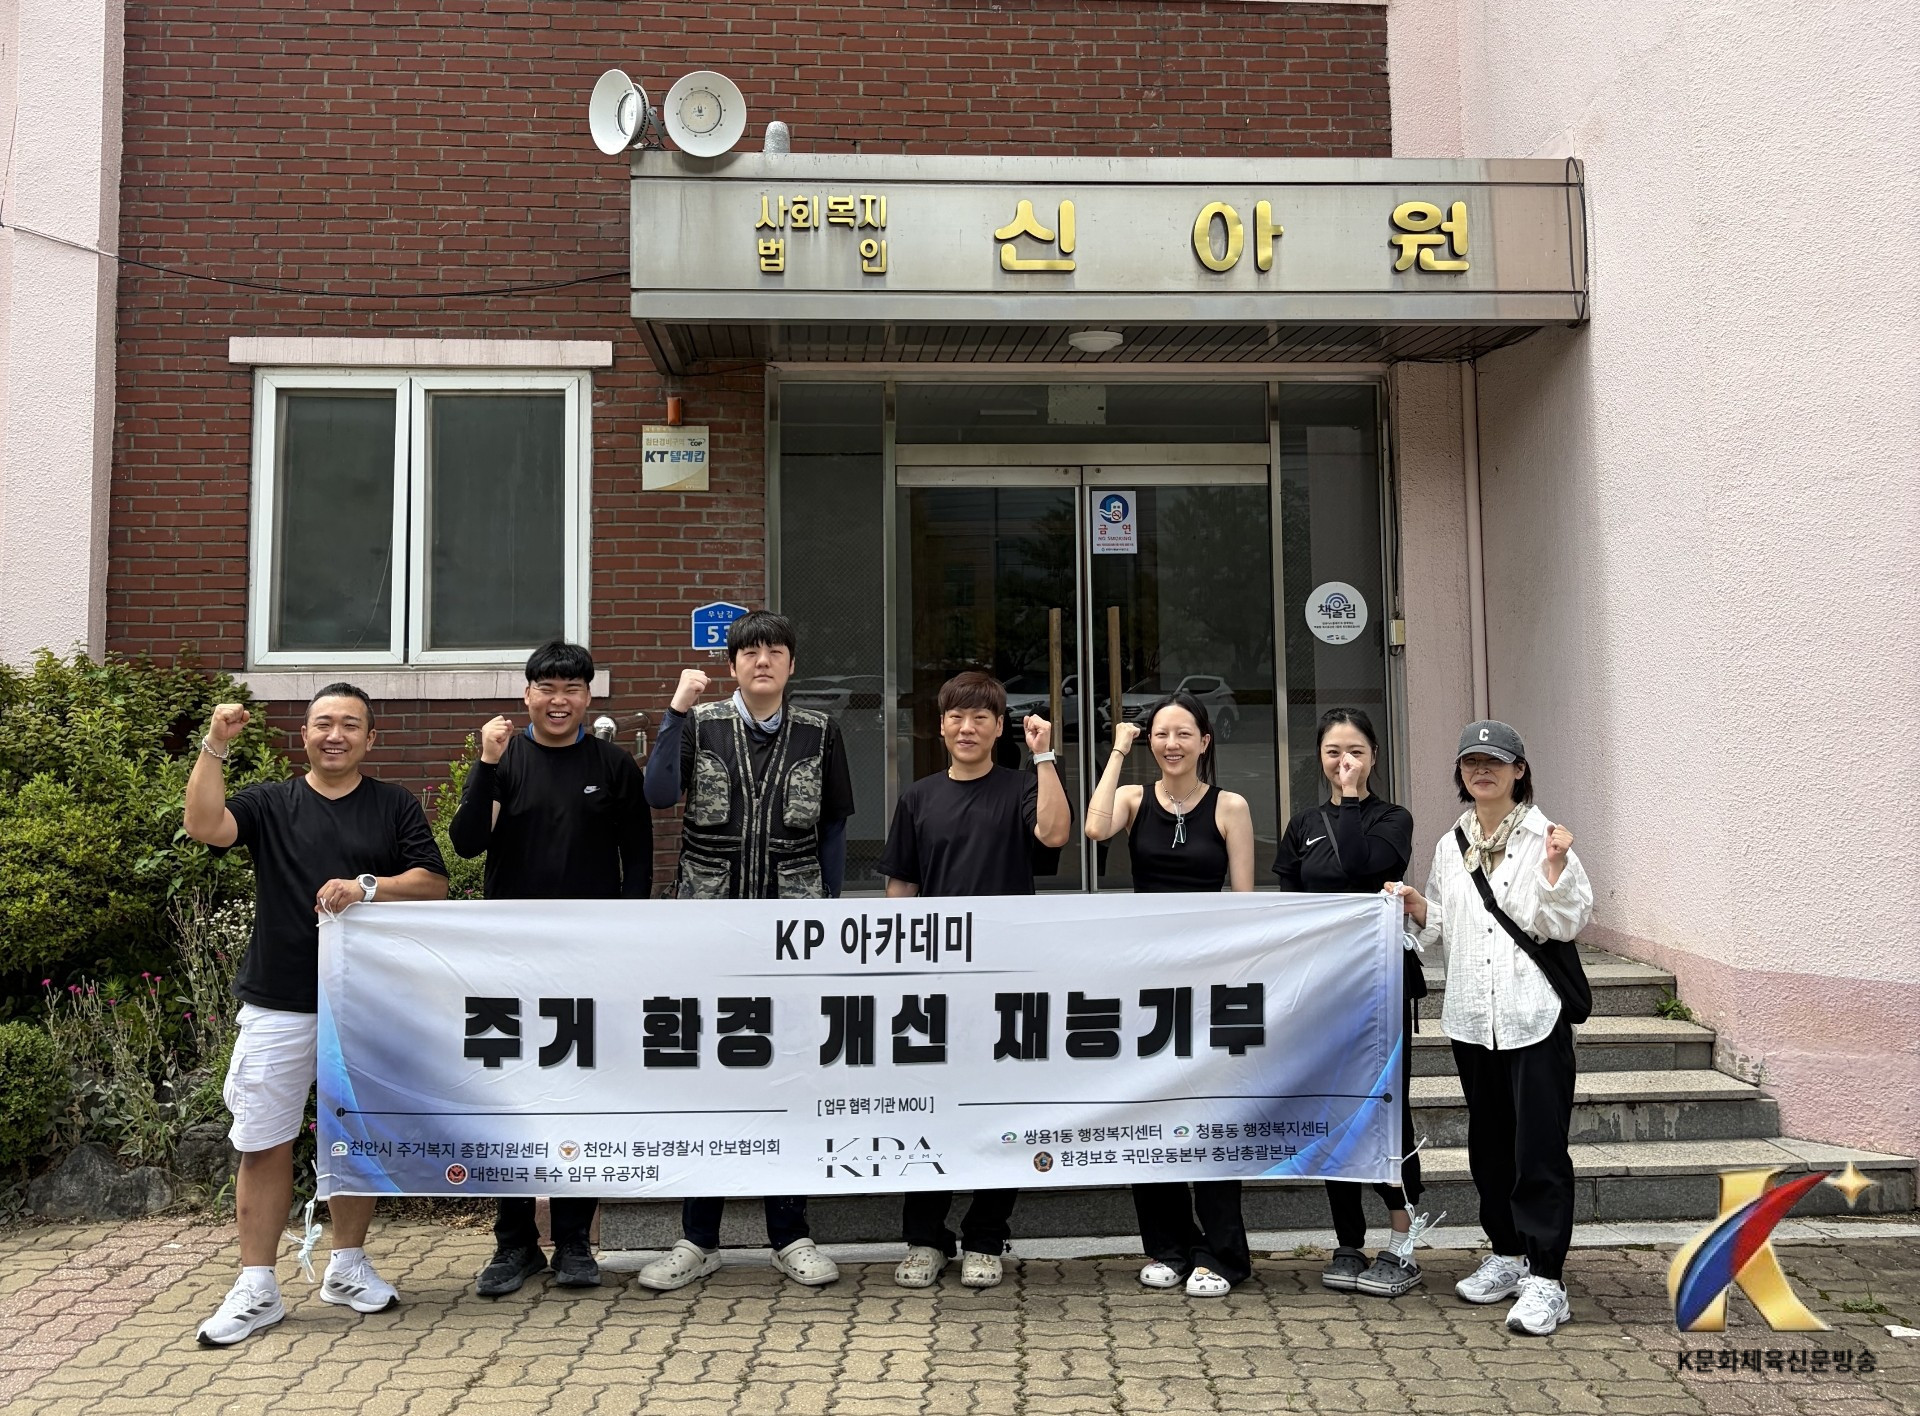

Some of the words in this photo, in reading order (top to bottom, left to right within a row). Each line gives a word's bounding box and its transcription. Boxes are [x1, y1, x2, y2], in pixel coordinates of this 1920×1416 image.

[755, 194, 888, 230] 사회복지
[1478, 728, 1490, 742] C
[776, 919, 825, 961] KP
[841, 911, 974, 965] 아카데미
[463, 996, 596, 1068] 주거
[643, 996, 774, 1068] 환경
[820, 992, 949, 1067] 개선
[994, 982, 1267, 1061] 재능기부
[849, 1097, 871, 1115] 협력
[873, 1096, 896, 1114] 기관
[1023, 1128, 1074, 1146] 쌍용1동
[1077, 1124, 1163, 1143] 행정복지센터
[1195, 1122, 1240, 1140] 청룡동
[1242, 1121, 1330, 1139] 행정복지센터
[350, 1140, 393, 1158] 천안시
[396, 1141, 455, 1159] 주거복지
[460, 1141, 549, 1159] 종합지원센터
[583, 1141, 627, 1158] 천안시
[631, 1139, 704, 1158] 동남경찰서
[708, 1138, 781, 1156] 안보협의회
[851, 1153, 943, 1161] ACADEMY
[1060, 1149, 1118, 1168] 환경보호
[1121, 1146, 1208, 1166] 국민운동본부
[1211, 1144, 1298, 1163] 충남총괄본부
[470, 1166, 530, 1183] 대한민국
[533, 1166, 564, 1183] 특수
[567, 1165, 598, 1183] 임무
[600, 1164, 660, 1182] 유공자회
